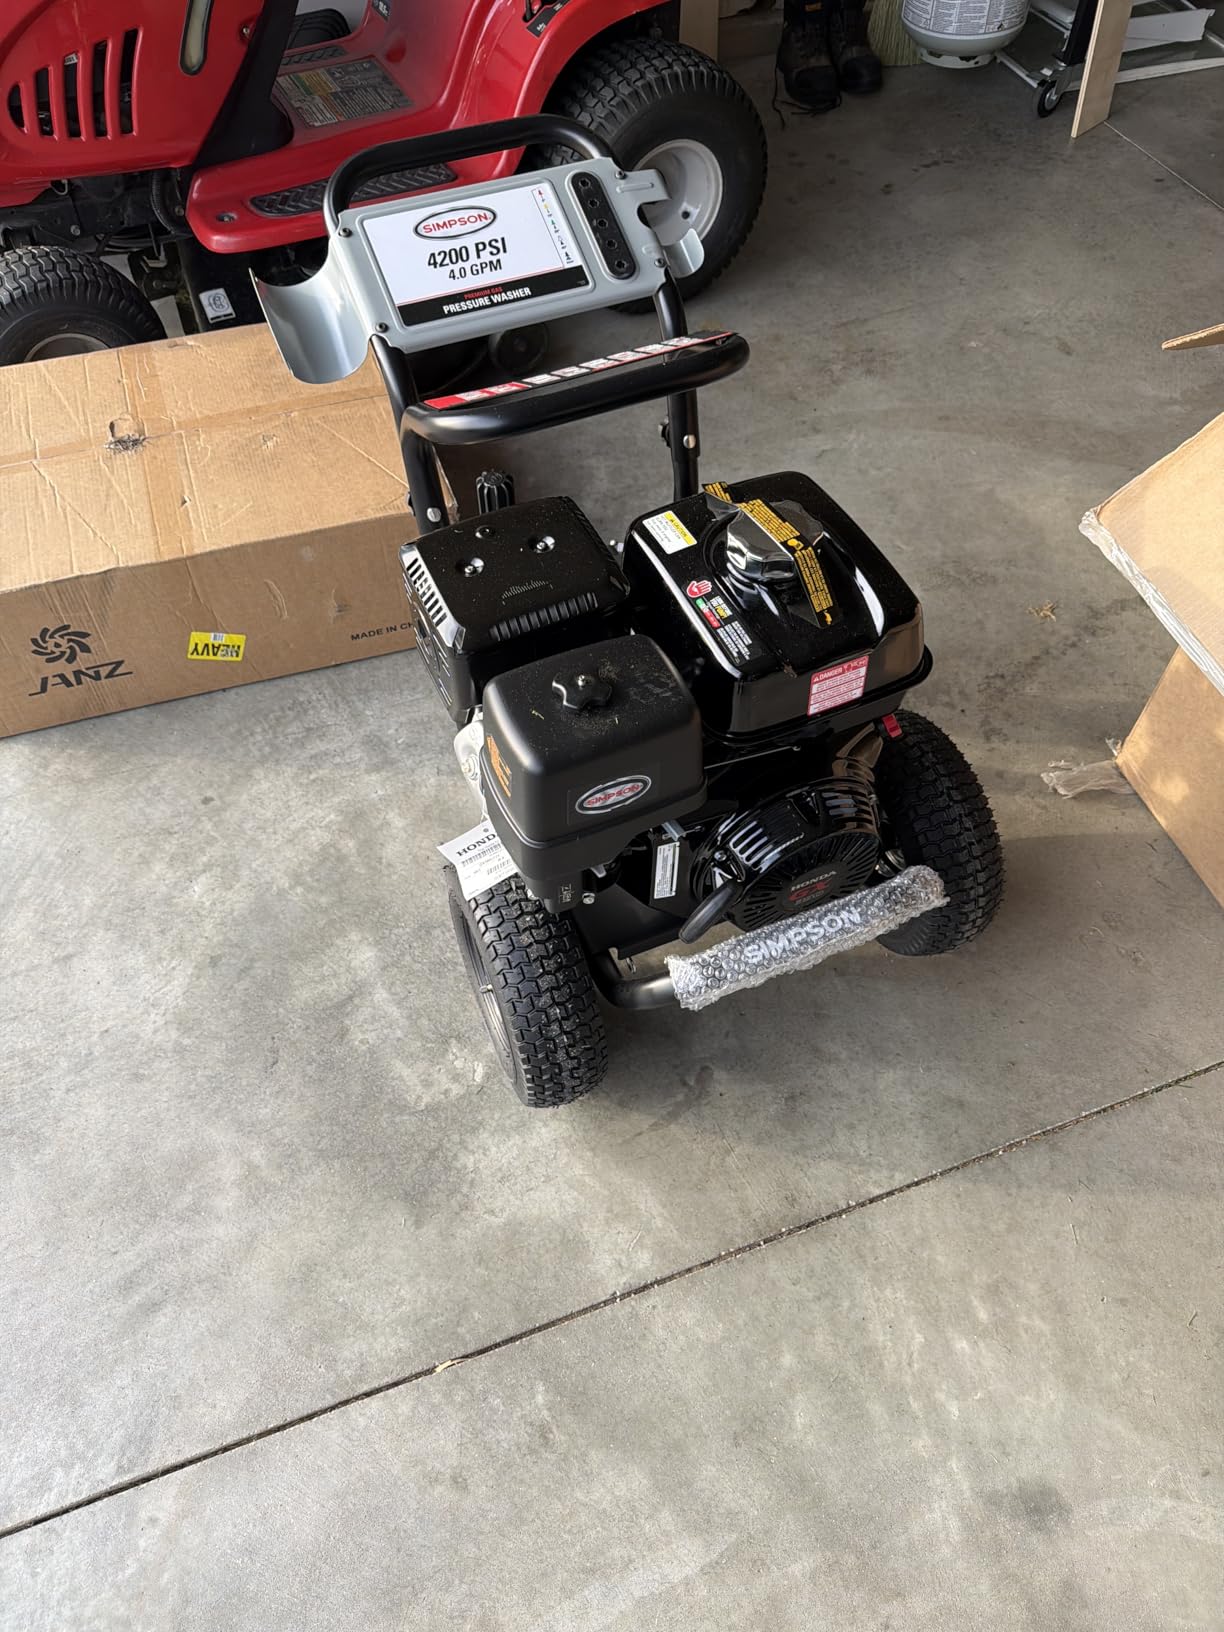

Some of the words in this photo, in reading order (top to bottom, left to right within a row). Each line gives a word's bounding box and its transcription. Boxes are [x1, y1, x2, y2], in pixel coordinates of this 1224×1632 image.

[422, 212, 489, 234] SIMPSON
[428, 245, 470, 269] 4200
[475, 237, 508, 260] PSI
[449, 266, 467, 281] 4.0
[471, 258, 503, 276] GPM
[443, 296, 491, 315] PRESSURE
[493, 286, 532, 304] WASHER
[464, 289, 490, 300] PREMIUM
[491, 287, 503, 296] GAS
[351, 628, 384, 641] MADE
[385, 624, 398, 633] IN
[189, 642, 241, 659] HEAVY
[28, 659, 133, 697] JANZ
[819, 667, 843, 679] DANGER
[586, 783, 641, 805] SIMPSON
[456, 833, 497, 857] HOND
[791, 870, 837, 891] HONDA
[743, 906, 861, 964] SIMPSON
